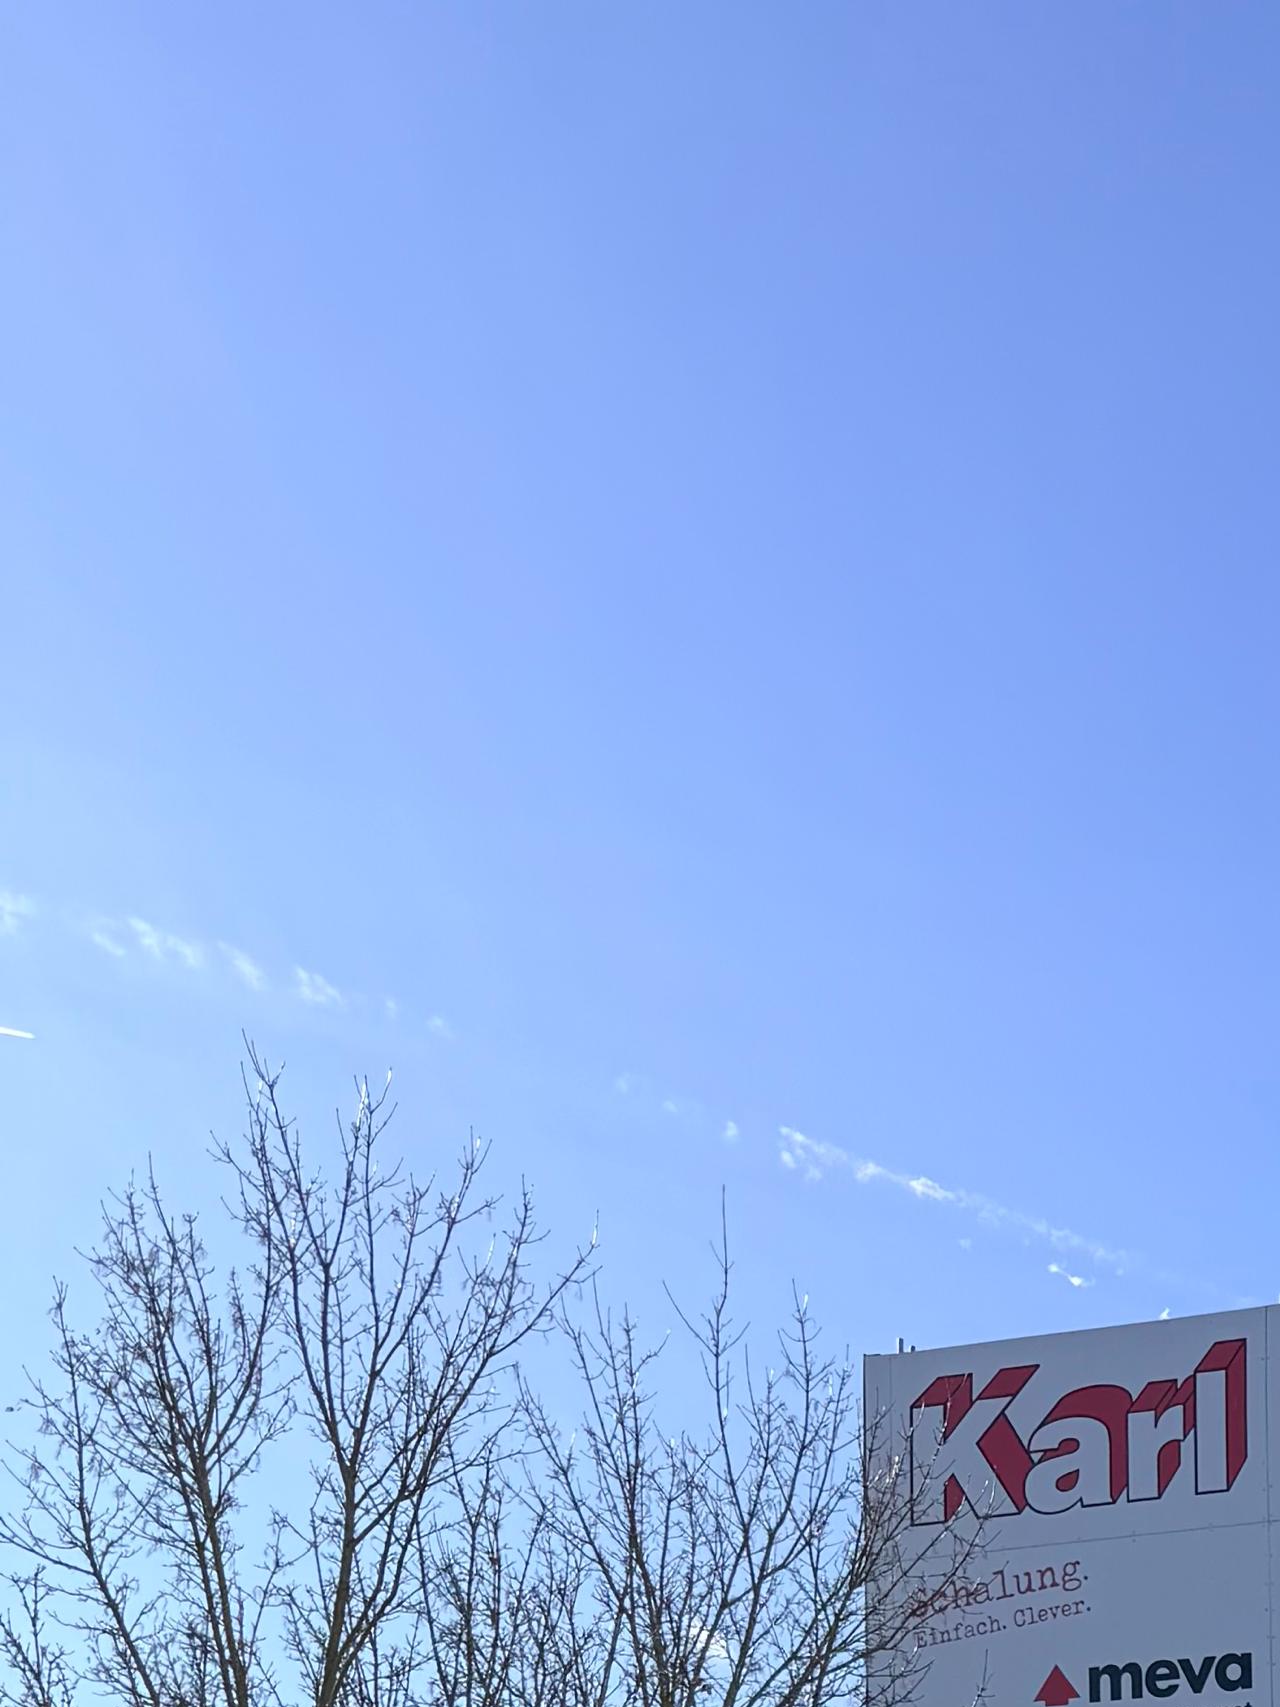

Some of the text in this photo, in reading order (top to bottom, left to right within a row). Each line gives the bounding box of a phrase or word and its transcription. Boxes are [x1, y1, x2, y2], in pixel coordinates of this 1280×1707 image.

[910, 1338, 1248, 1527] Karl
[914, 1599, 1092, 1649] Einfach. Clever.
[1088, 1652, 1253, 1703] meva
